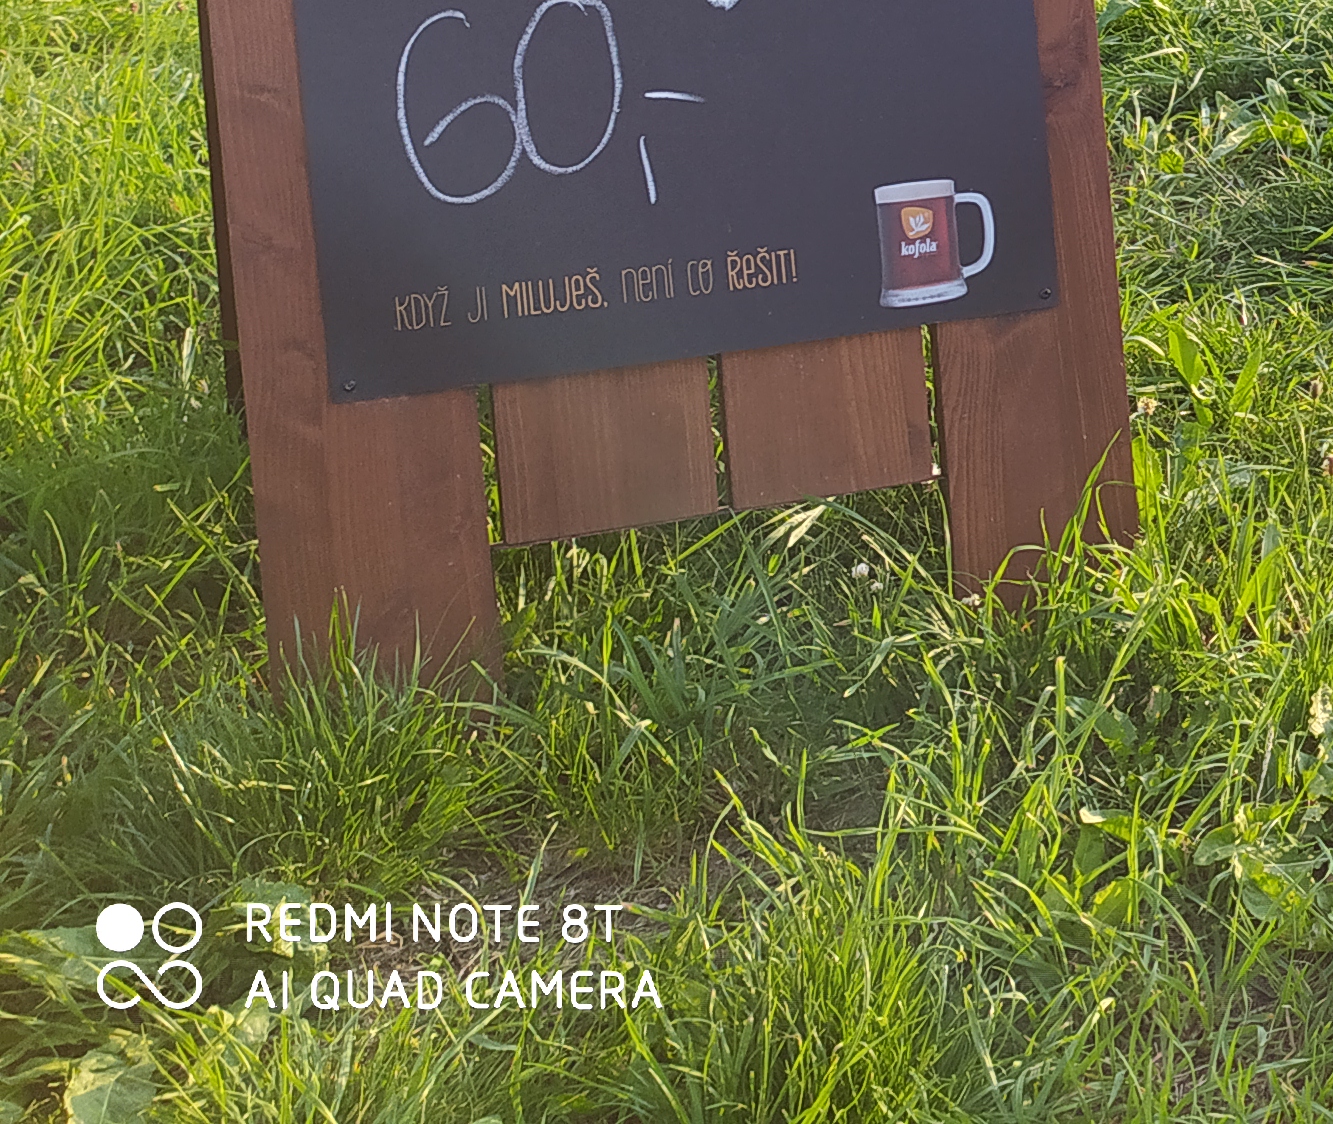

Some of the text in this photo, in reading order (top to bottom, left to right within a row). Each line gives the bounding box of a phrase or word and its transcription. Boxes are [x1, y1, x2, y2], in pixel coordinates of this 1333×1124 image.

[901, 237, 938, 259] kofola
[394, 285, 451, 332] KDYŽ
[467, 286, 488, 323] JI
